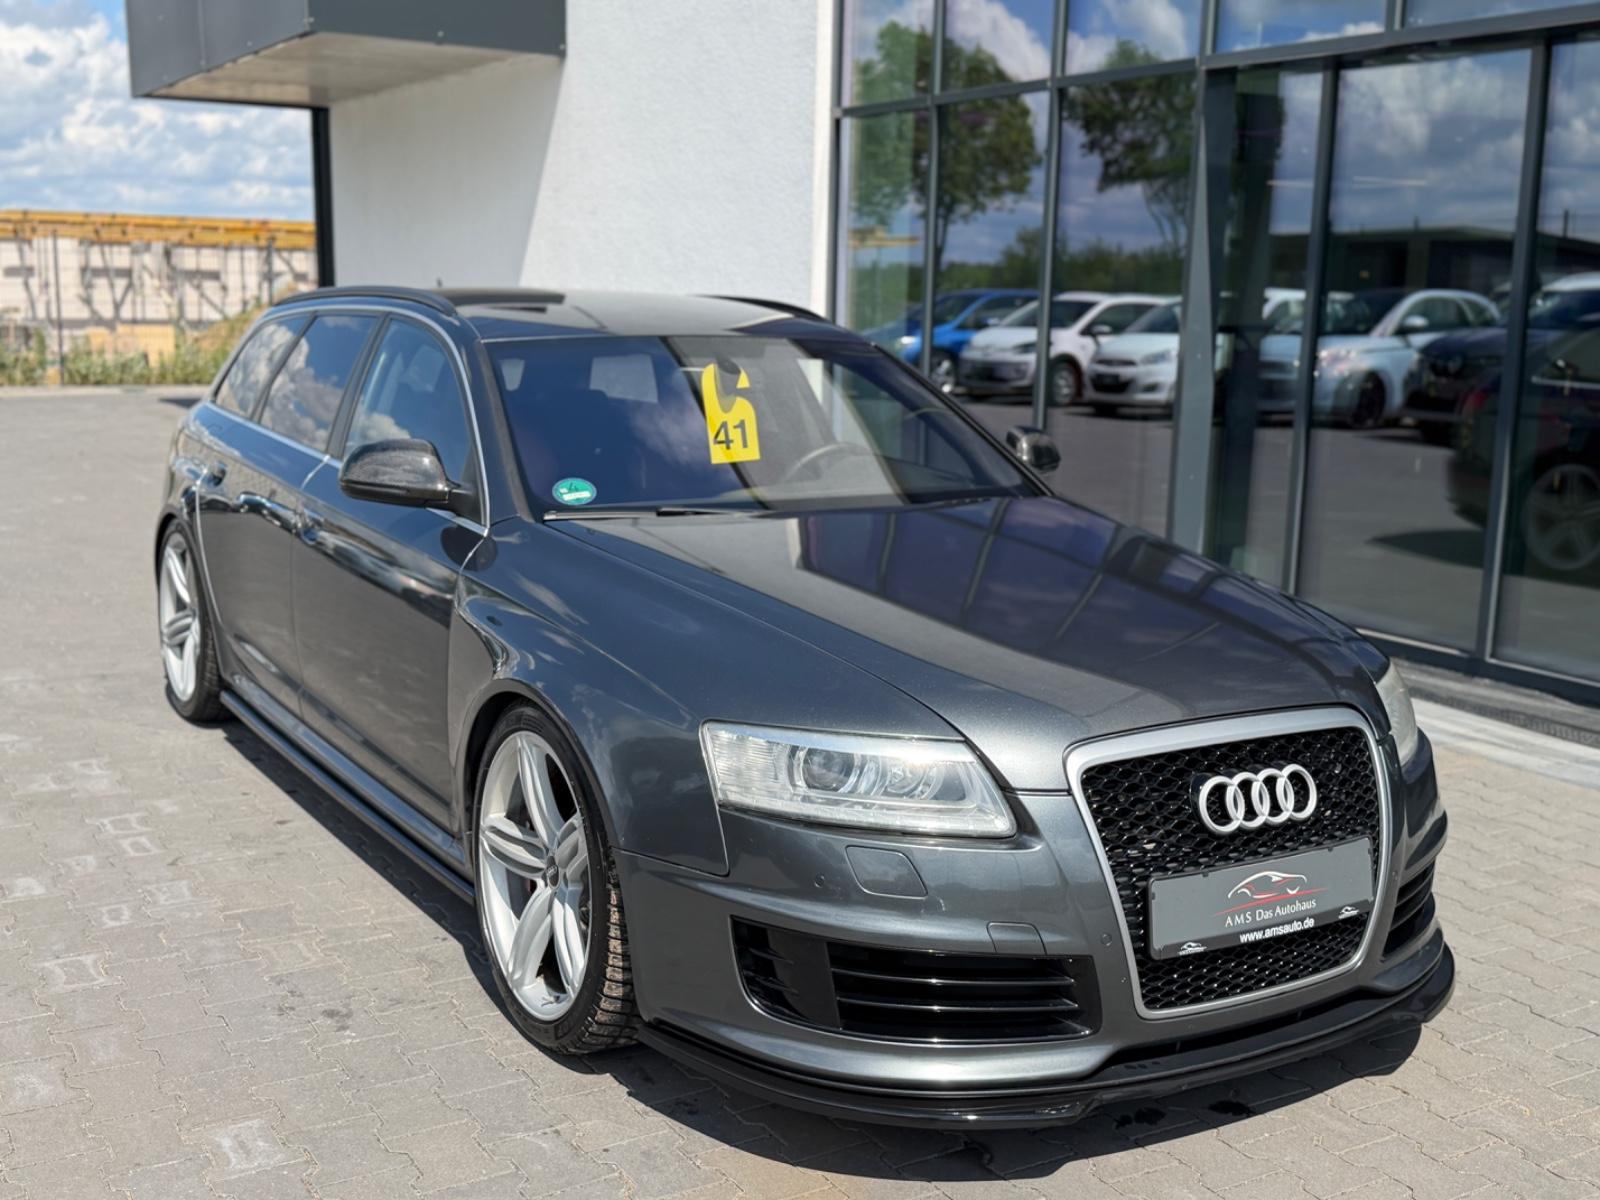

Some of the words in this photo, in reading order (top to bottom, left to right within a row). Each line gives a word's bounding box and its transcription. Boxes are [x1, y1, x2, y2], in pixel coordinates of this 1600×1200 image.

[713, 419, 748, 450] 41
[1256, 909, 1273, 921] Das
[1275, 899, 1317, 917] Autohaus
[1240, 917, 1315, 943] www.amsauto.de
